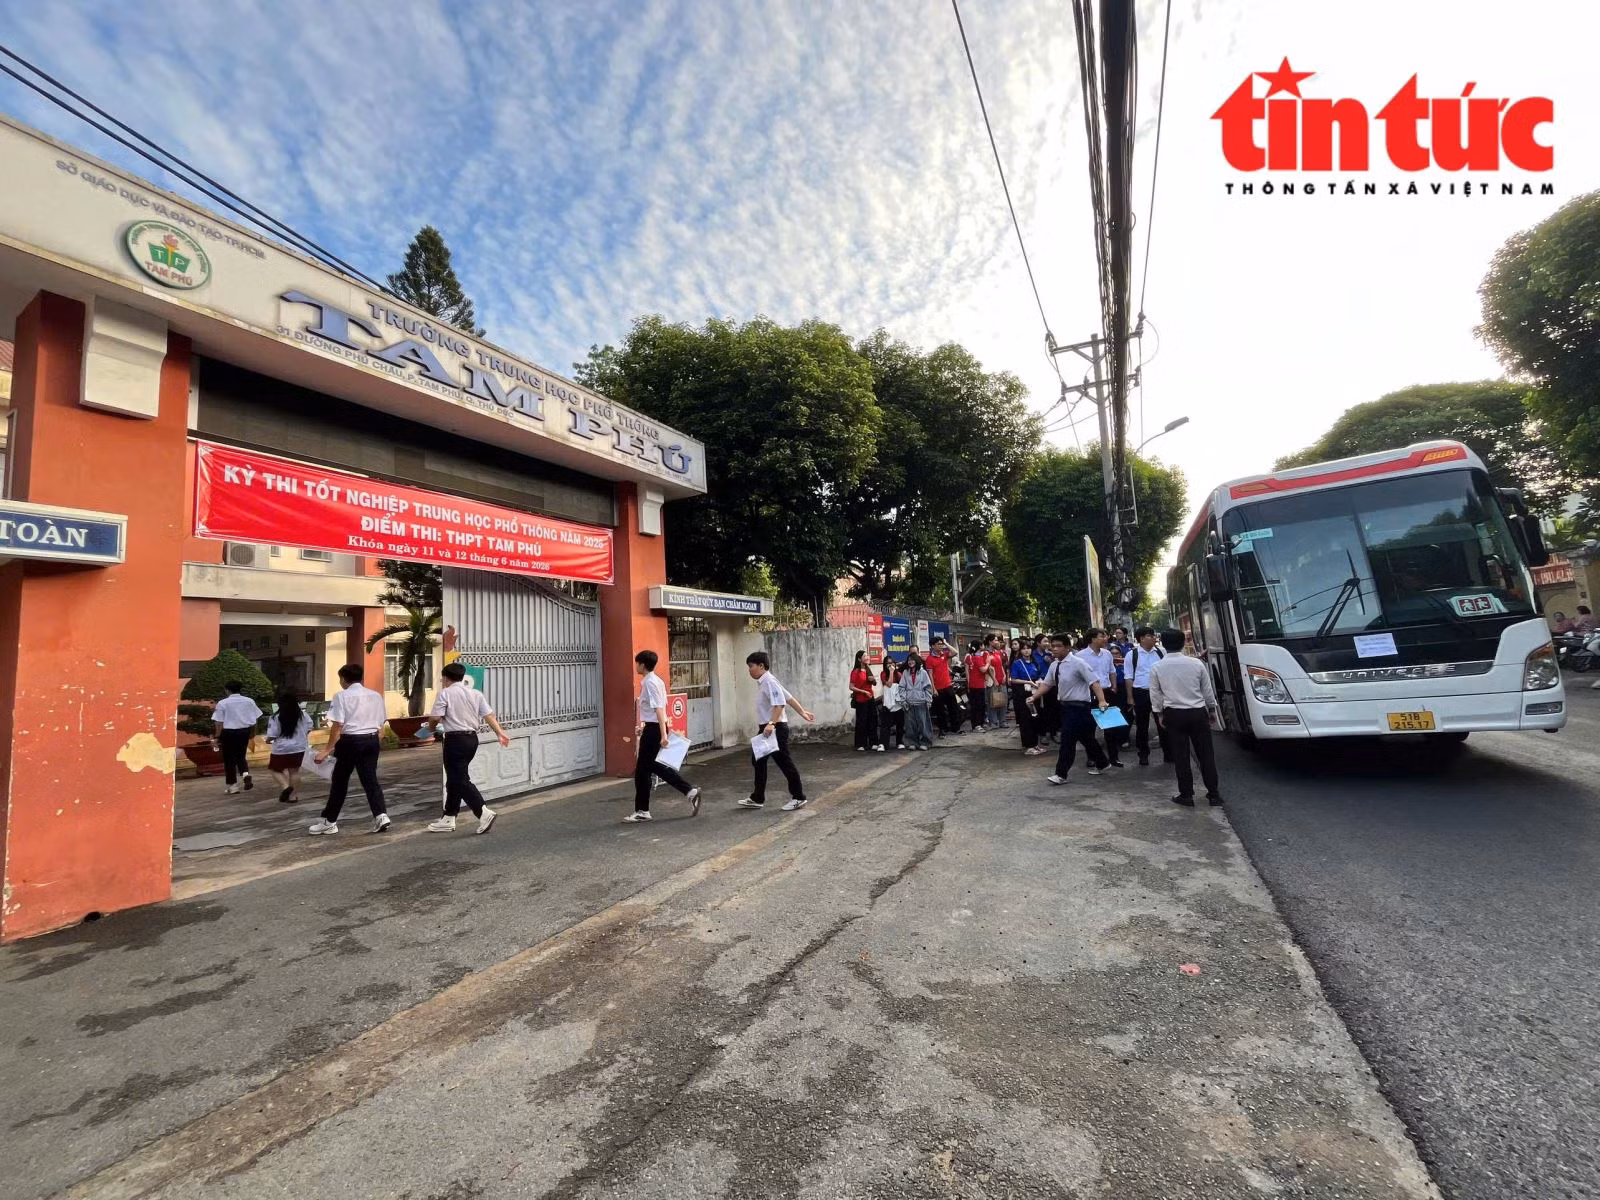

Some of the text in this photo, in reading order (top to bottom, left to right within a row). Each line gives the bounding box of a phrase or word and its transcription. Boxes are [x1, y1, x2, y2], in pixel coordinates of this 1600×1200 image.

[81, 171, 116, 192] GIÁO
[145, 260, 169, 277] TAM
[276, 325, 290, 336] 31
[294, 331, 342, 354] ĐƯỜNG
[418, 379, 439, 391] TAM
[367, 301, 659, 440] TRƯỜNG TRUNG HỌC PHỔ THÔNG
[279, 289, 692, 474] TAM PHÚ
[224, 464, 256, 487] KỲ
[262, 472, 298, 494] THI
[303, 478, 341, 502] TỐT
[346, 488, 409, 516] NGHIỆP
[412, 501, 461, 524] TRUNG
[464, 512, 491, 531] HỌC
[494, 516, 519, 534] PHỔ
[521, 523, 558, 541] THÔNG
[560, 530, 581, 545] NĂM
[347, 535, 551, 571] Khóa ngày 11 và 12 tháng 6 năm 2026
[360, 512, 542, 557] ĐIỂM THI: THPT TAM PHÚ
[1394, 720, 1430, 729] 215.17
[1399, 713, 1420, 721] 51B
